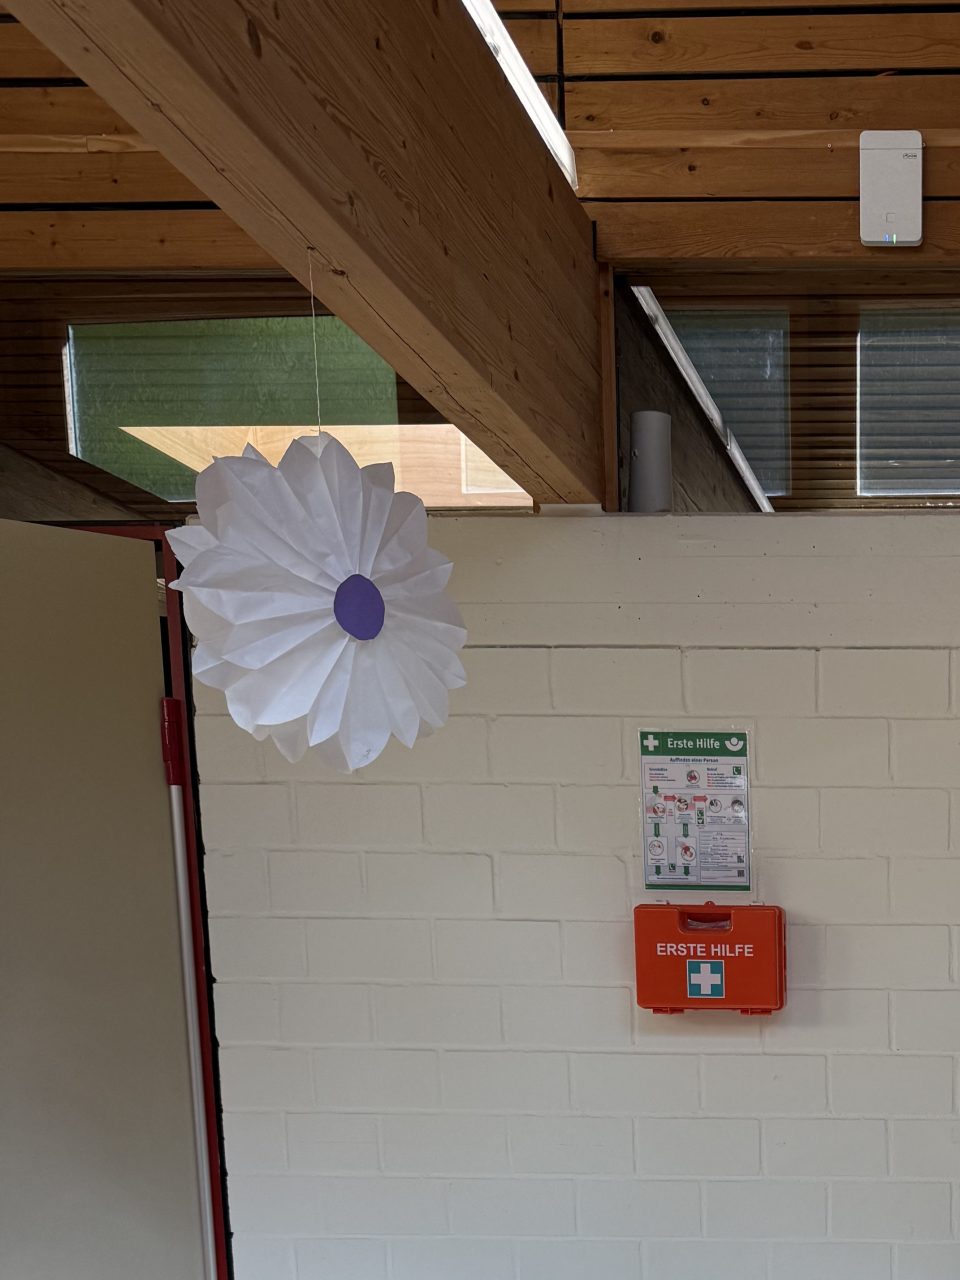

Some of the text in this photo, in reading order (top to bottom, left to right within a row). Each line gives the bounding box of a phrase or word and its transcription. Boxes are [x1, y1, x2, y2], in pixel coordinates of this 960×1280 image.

[667, 738, 721, 749] Erste Hilfe
[656, 943, 754, 957] ERSTE HILFE
